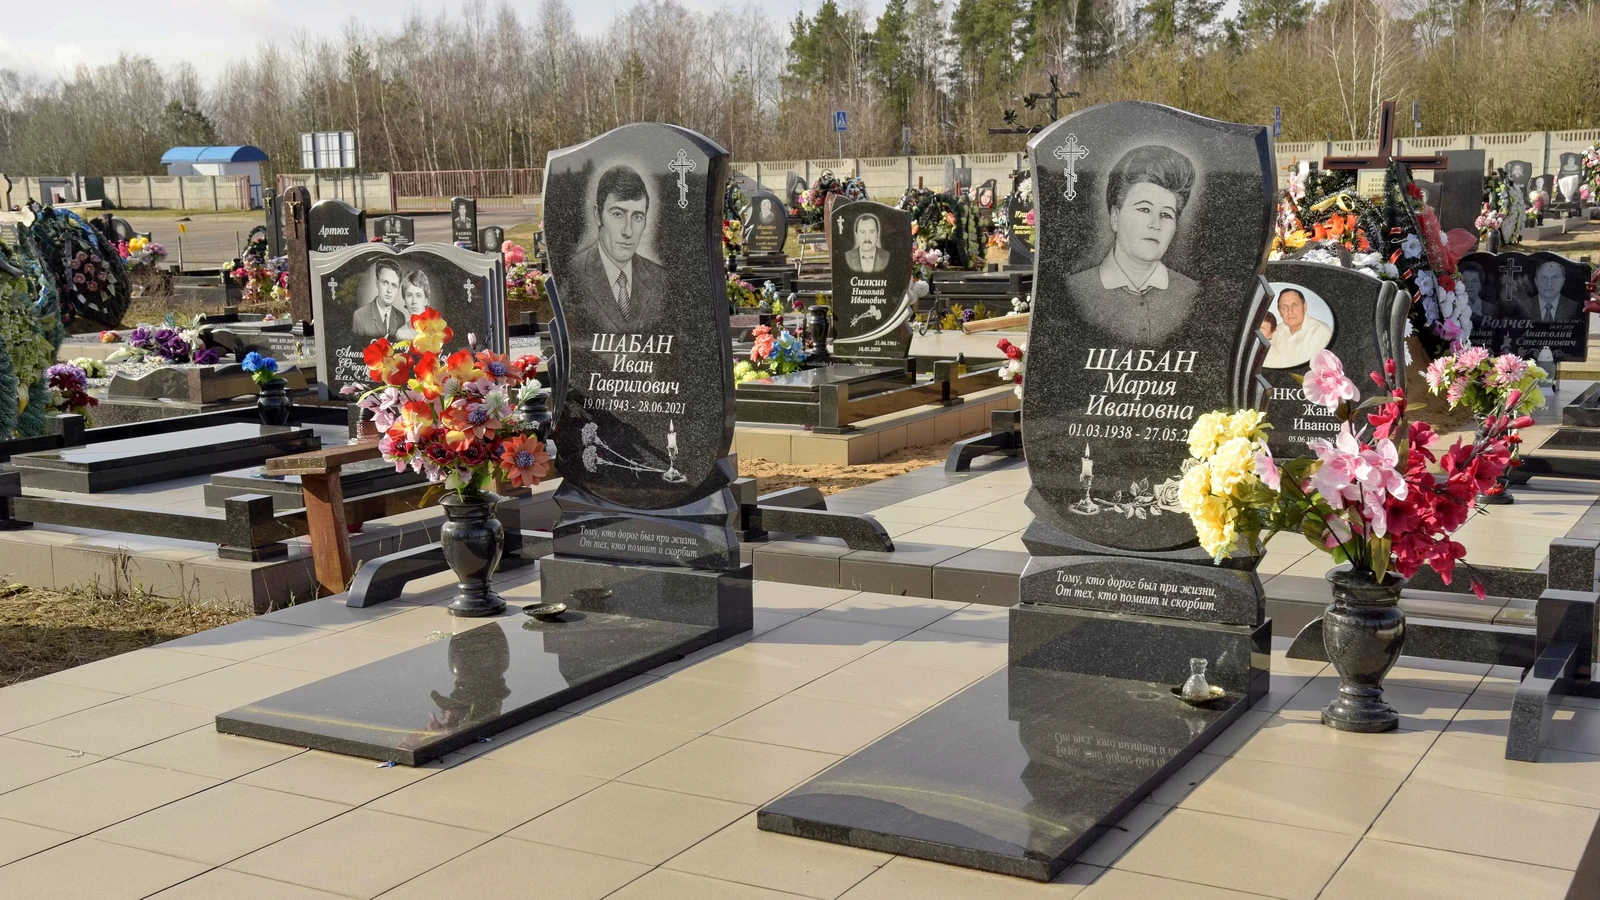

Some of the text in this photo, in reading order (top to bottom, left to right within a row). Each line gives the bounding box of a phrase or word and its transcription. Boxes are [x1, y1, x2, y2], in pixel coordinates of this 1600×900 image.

[318, 224, 350, 238] Артюх
[850, 276, 888, 287] Силкин
[850, 296, 887, 304] Иванович
[851, 287, 885, 296] Николай
[1481, 315, 1536, 329] Волчек
[1522, 329, 1572, 338] Анатолий
[590, 333, 674, 354] ШАБАН
[611, 354, 654, 373] Иван
[1083, 348, 1199, 373] ШАБАН
[587, 372, 680, 397] Гаврилович
[1102, 372, 1177, 401] Мария
[1269, 387, 1307, 401] НКО
[583, 397, 629, 411] 19.01.1943
[638, 400, 686, 414] 28.06.2021
[1084, 394, 1194, 420] Ивановна
[1068, 423, 1133, 439] 01.03.1938
[1143, 427, 1189, 442] 27.05.2
[1293, 418, 1340, 431] Иванов
[580, 525, 699, 547] Тому, кто дорог был при жизни,
[579, 537, 592, 548] От
[593, 540, 610, 551] тех,
[611, 542, 626, 551] кто
[627, 543, 657, 554] помнит
[664, 546, 699, 559] скорбит.
[1056, 570, 1217, 598] Тому, кто дорог был при жизни,
[1055, 584, 1217, 612] От тех, кто помнит и скорбит.
